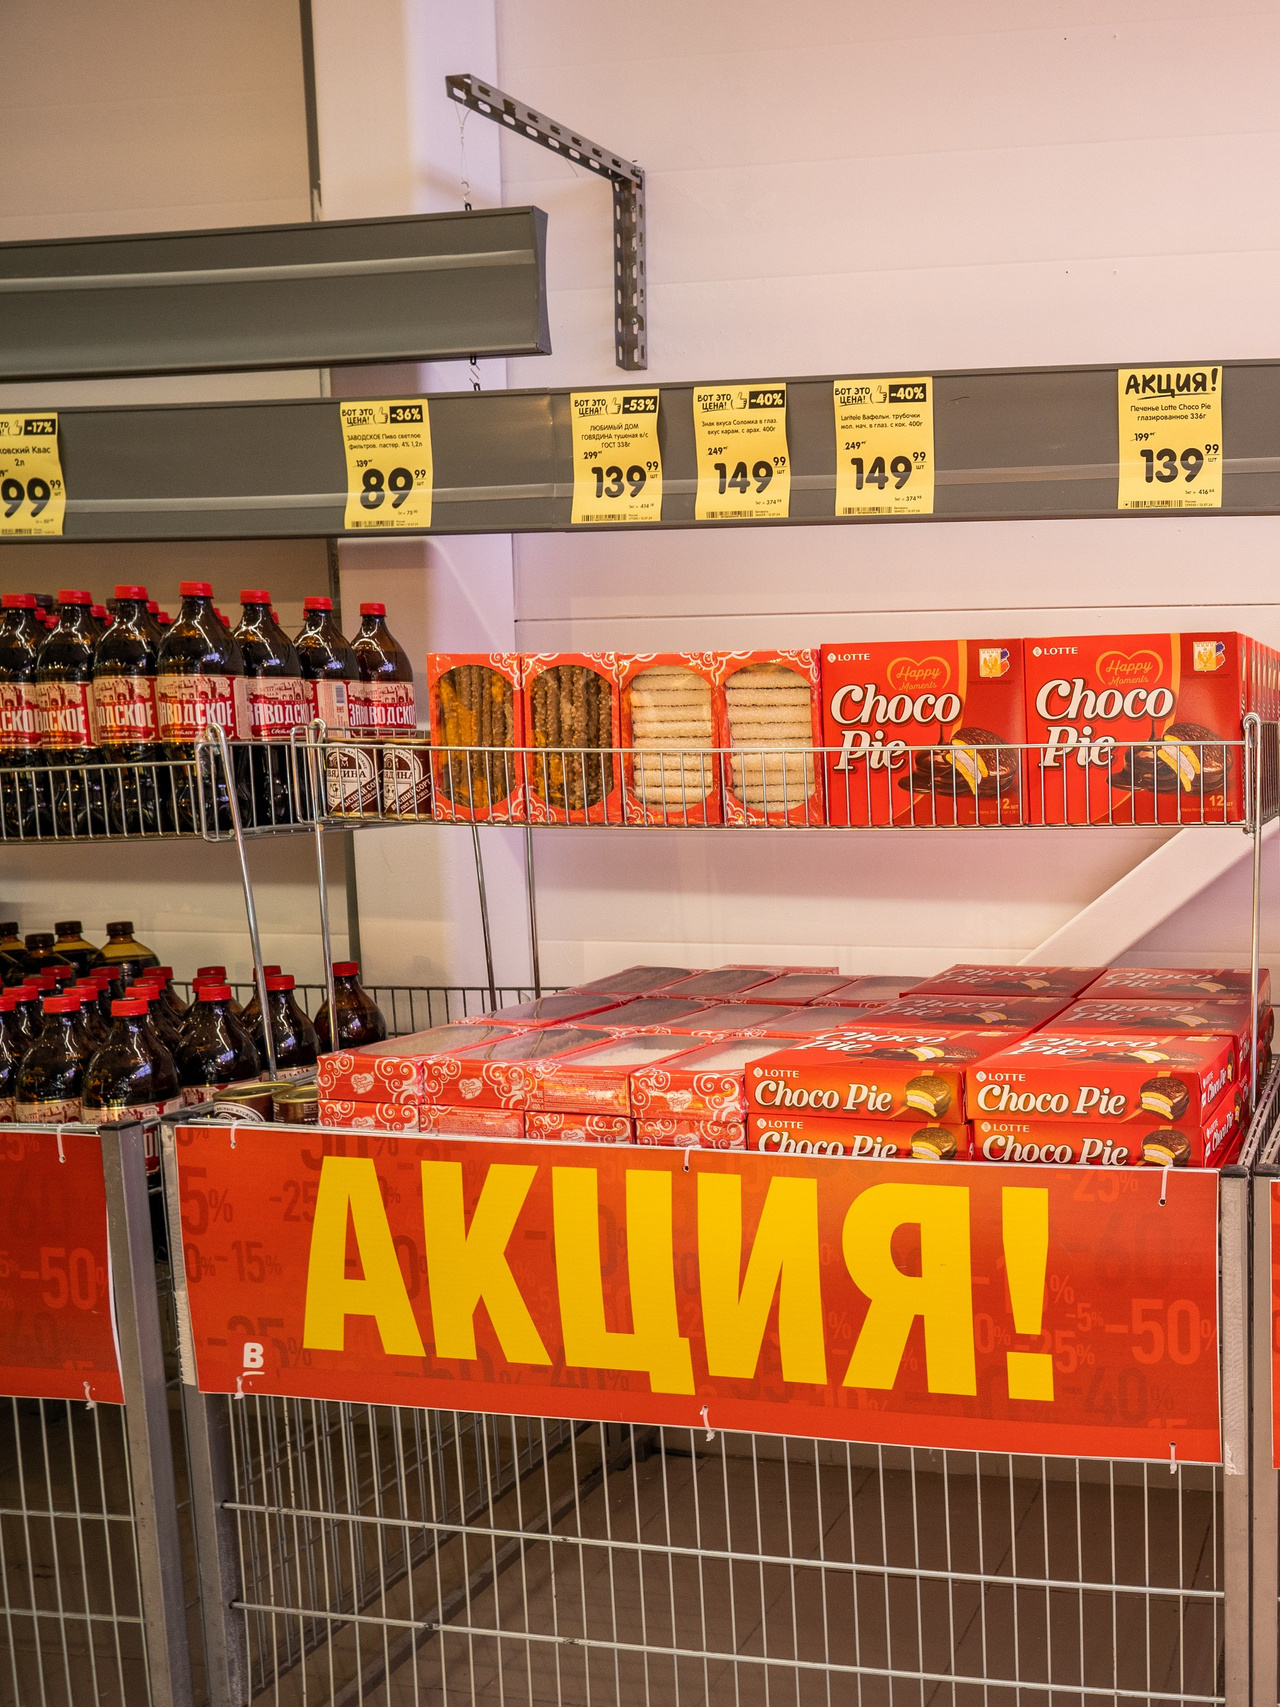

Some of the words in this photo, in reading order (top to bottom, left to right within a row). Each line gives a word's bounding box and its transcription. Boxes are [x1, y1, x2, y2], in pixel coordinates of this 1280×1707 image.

[1125, 368, 1218, 398] АКЦИЯ!
[698, 394, 714, 402] ВОТ
[751, 393, 782, 405] -40%
[891, 387, 924, 400] -40%
[579, 407, 602, 417] ЦЕНА!
[624, 399, 655, 411] -53%
[702, 402, 726, 412] ЦЕНА!
[347, 417, 369, 426] ЦЕНА!
[391, 409, 420, 420] -36%
[1138, 414, 1188, 422] глазированное
[27, 422, 52, 433] -17%
[32, 446, 50, 454] Квас
[851, 456, 912, 490] 149
[913, 452, 926, 461] 99
[1140, 448, 1203, 483] 139
[1205, 444, 1219, 453] 99
[592, 465, 646, 498] 139
[646, 461, 658, 470] 99
[714, 461, 773, 494] 149
[773, 457, 786, 466] 99
[360, 467, 413, 509] 89
[415, 470, 426, 478] 99
[1, 478, 50, 518] 99
[50, 480, 61, 488] 99
[838, 653, 870, 661] LOTTE
[1043, 647, 1078, 655] LOTTE
[896, 665, 940, 682] Happy
[1106, 659, 1152, 675] Happy
[830, 684, 961, 724] Choco
[1036, 679, 1173, 719] Choco
[160, 701, 234, 727] АВОДСКОЕ
[833, 729, 906, 770] Pie
[1038, 726, 1116, 768] Pie
[764, 1069, 799, 1078] LOTTE
[988, 1073, 1025, 1082] LOTTE
[755, 1080, 840, 1111] Choco
[843, 1084, 892, 1112] Pie
[976, 1084, 1069, 1114] Choco
[1073, 1088, 1125, 1116] Pie
[768, 1121, 803, 1129] LOTTE
[993, 1123, 1030, 1132] LOTTE
[981, 1135, 1072, 1165] Choco
[1078, 1138, 1128, 1166] Pie
[303, 1156, 1054, 1401] АКЦИЯ!
